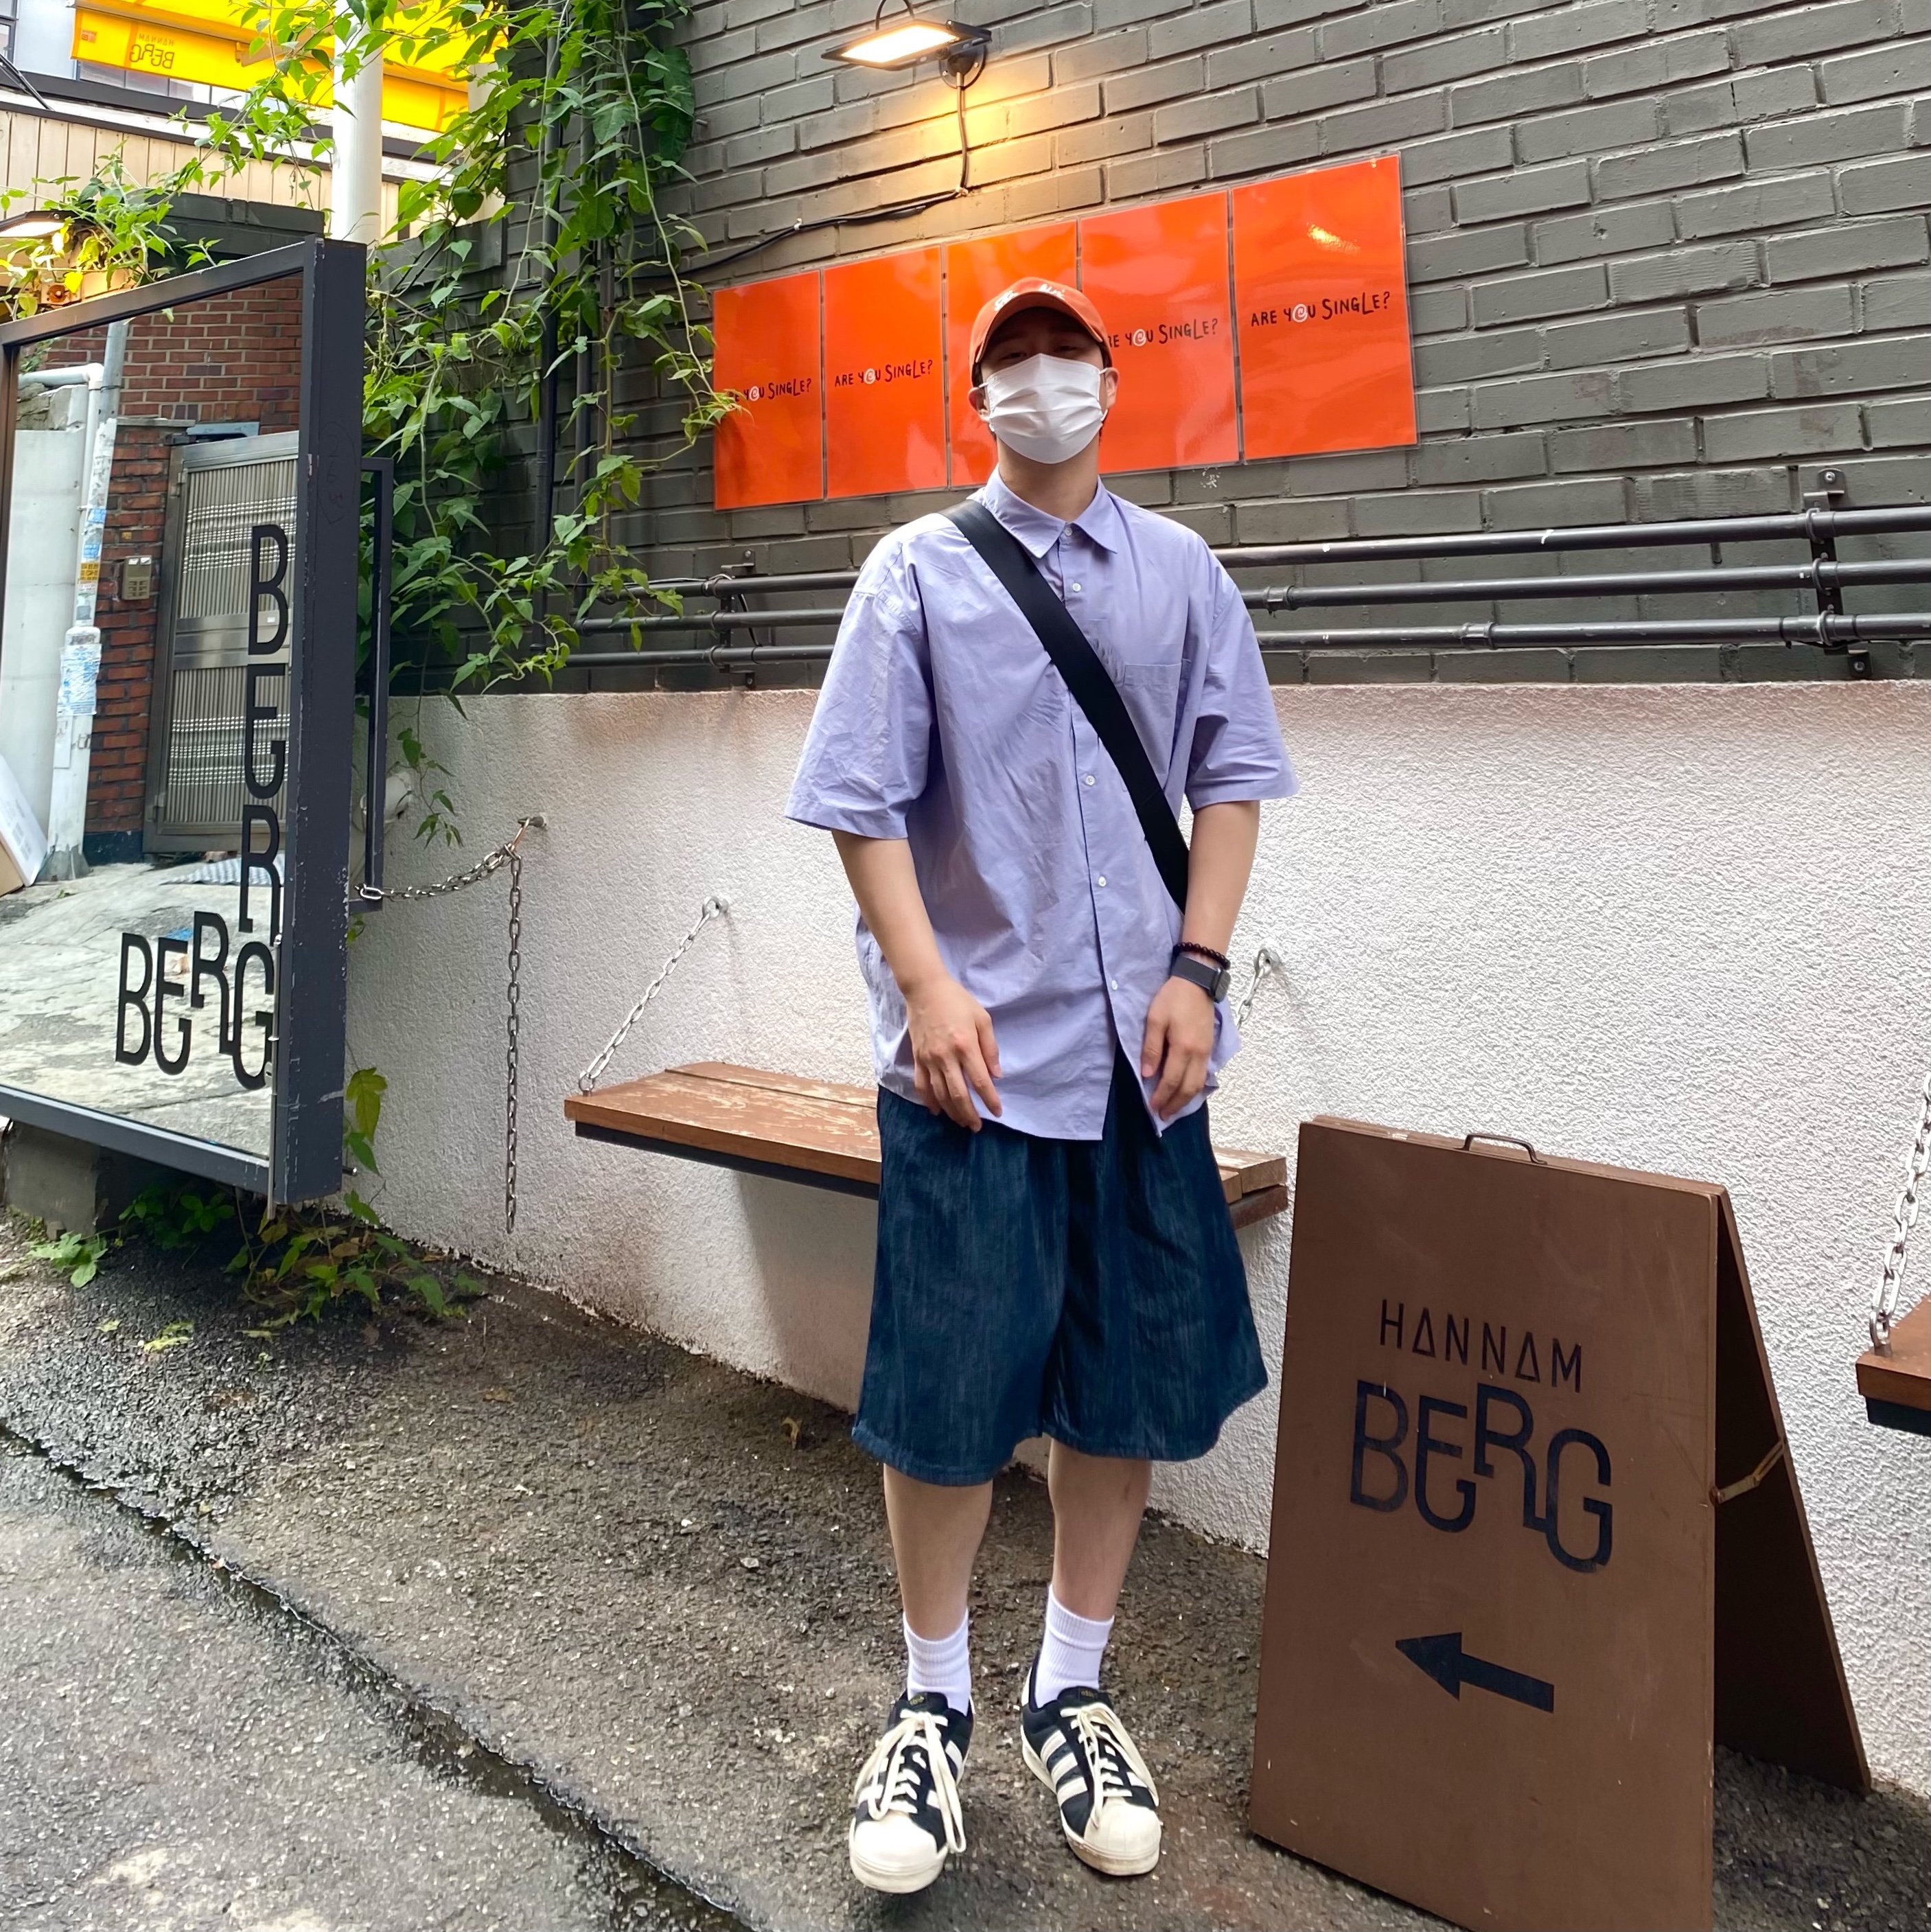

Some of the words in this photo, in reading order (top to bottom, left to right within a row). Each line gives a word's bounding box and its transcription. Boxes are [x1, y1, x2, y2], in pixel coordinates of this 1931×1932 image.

[1251, 310, 1277, 327] ARE
[1322, 291, 1390, 320] SINGLE?
[1159, 318, 1218, 345] SINGLE?
[767, 378, 811, 400] SINGLE?
[834, 373, 854, 387] ARE
[884, 359, 933, 382] SINGLE?
[115, 911, 275, 1090] BERG
[1380, 1299, 1582, 1393] HANNAM
[1350, 1379, 1612, 1573] BERG
